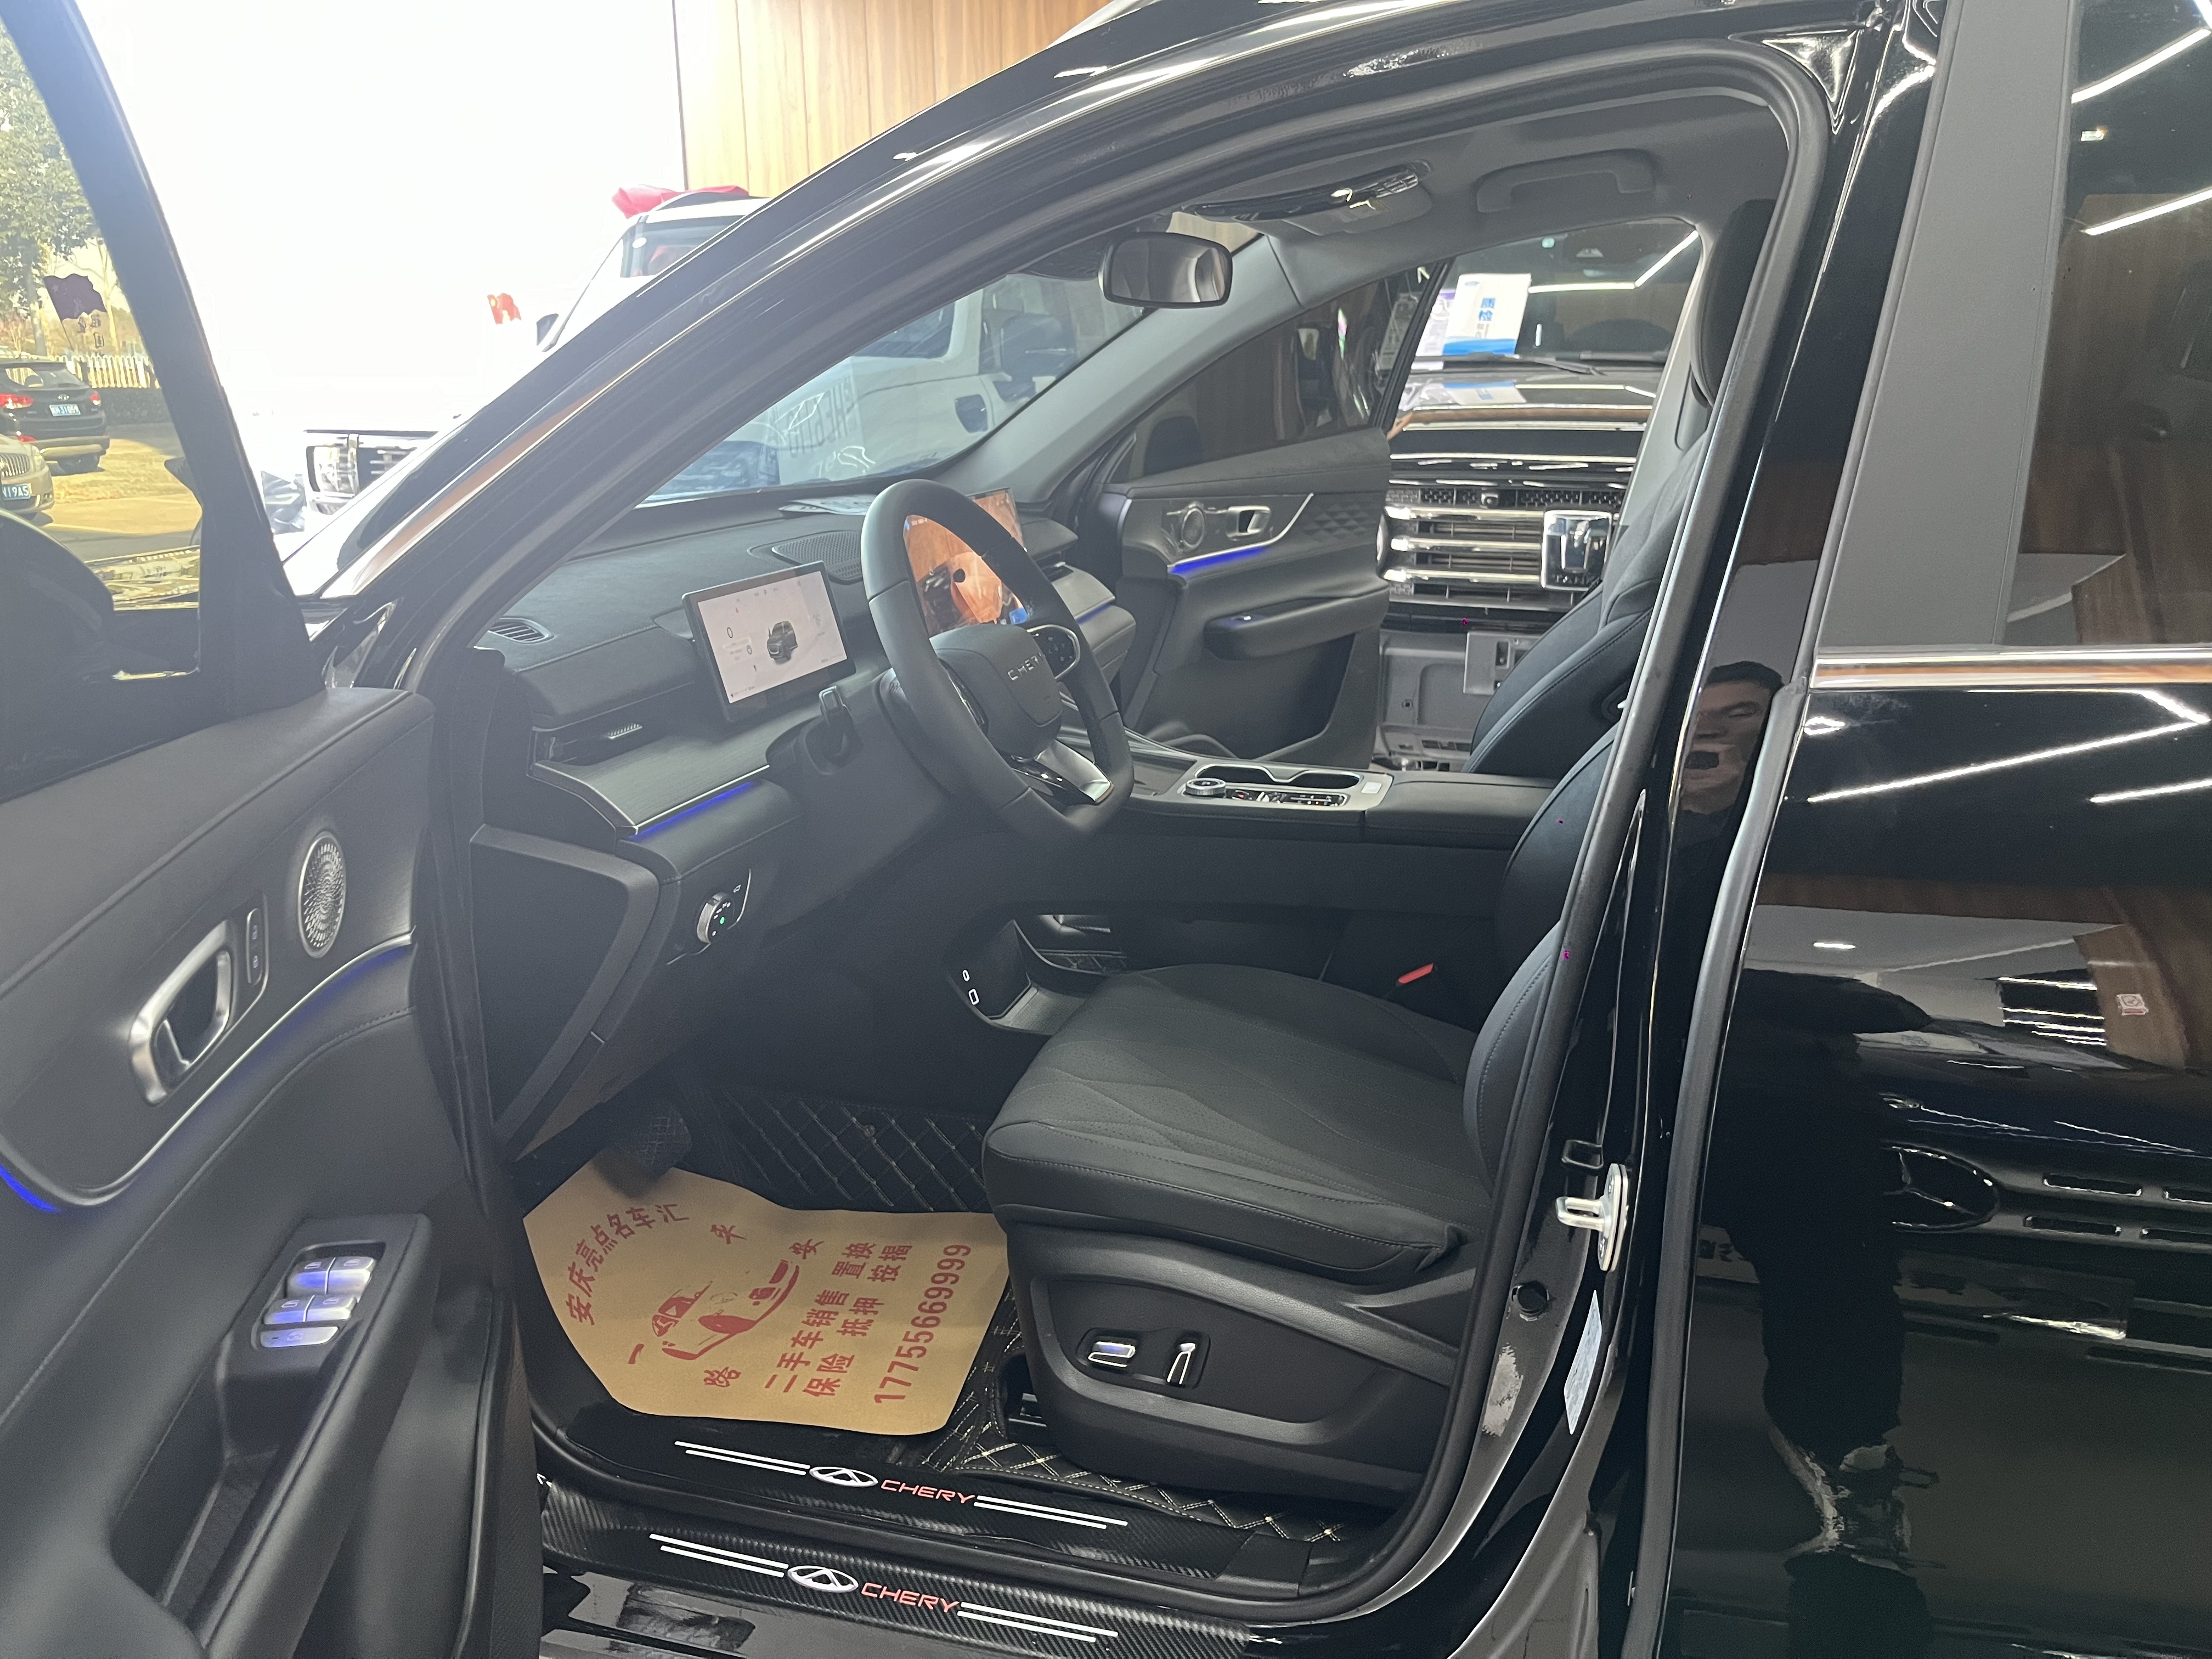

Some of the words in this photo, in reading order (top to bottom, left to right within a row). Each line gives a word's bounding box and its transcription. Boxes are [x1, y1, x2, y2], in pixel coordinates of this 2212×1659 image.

[565, 1204, 690, 1325] 安庆亮点名车汇
[765, 1290, 850, 1393] 二手车销售
[831, 1242, 877, 1279] 置换
[802, 1353, 855, 1397] 保险
[836, 1297, 885, 1336] 抵押
[867, 1245, 913, 1282] 按揭
[874, 1244, 971, 1404] 17755669999
[881, 1479, 975, 1504] CHERY
[861, 1582, 960, 1613] CHERY
